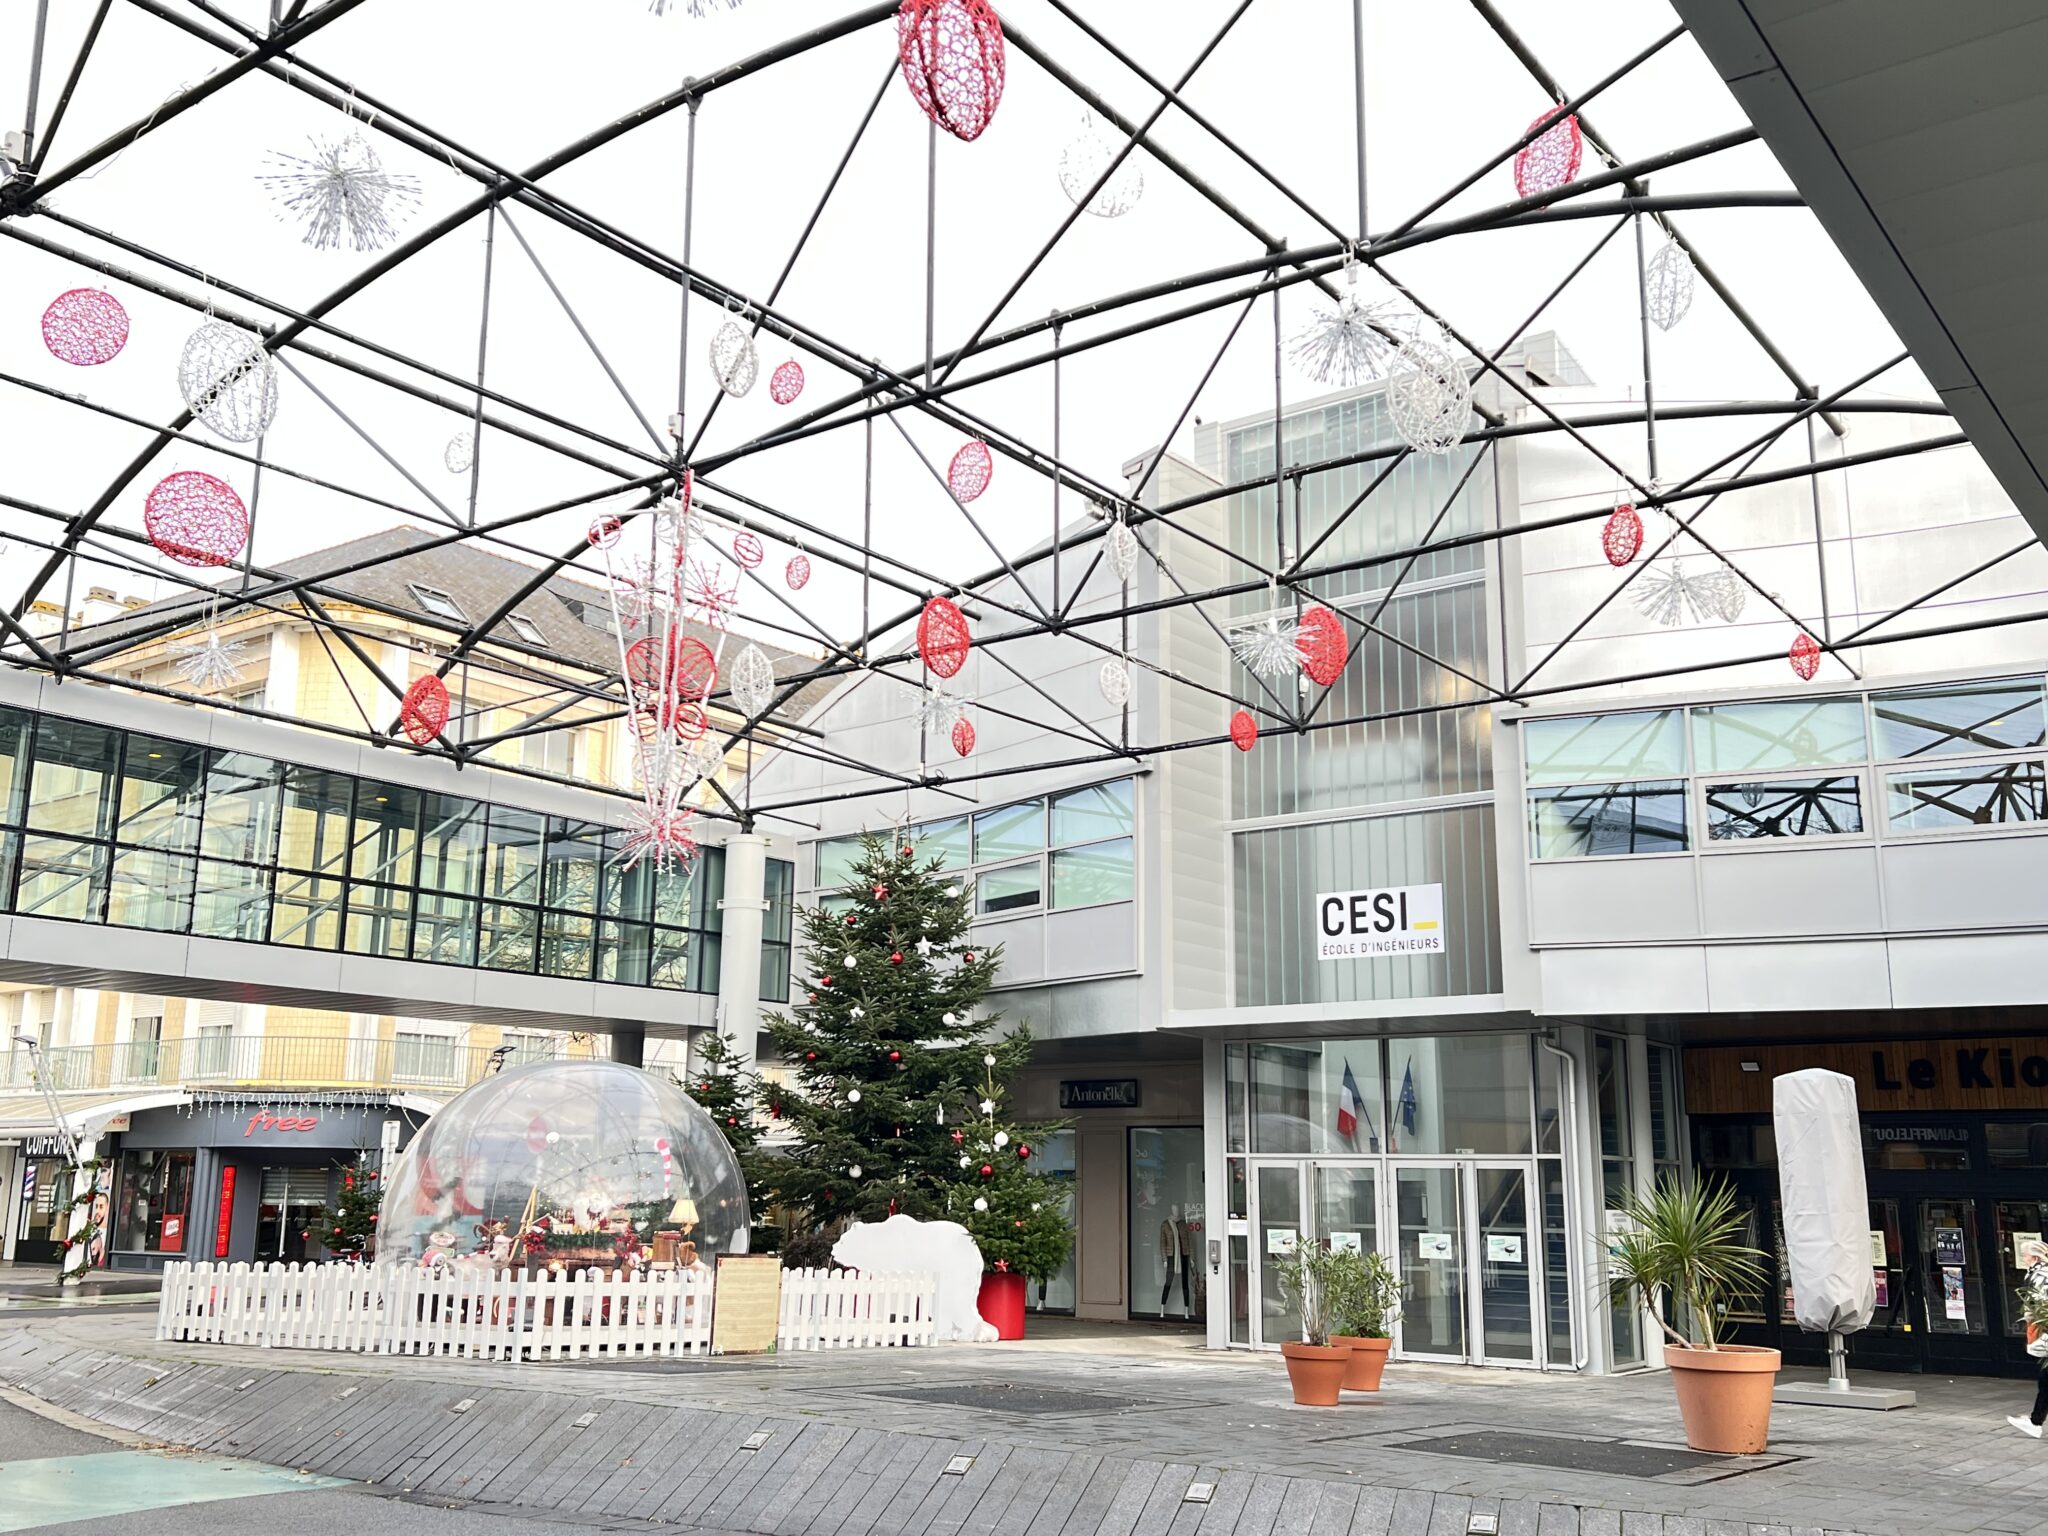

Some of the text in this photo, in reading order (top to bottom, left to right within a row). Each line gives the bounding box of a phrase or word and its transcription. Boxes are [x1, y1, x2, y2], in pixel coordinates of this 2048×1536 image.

[1322, 892, 1408, 937] CESI
[1323, 938, 1440, 955] ÉCOLE D'INGÉNIEURS
[1872, 1048, 2048, 1090] Le Kio
[244, 1109, 319, 1137] free
